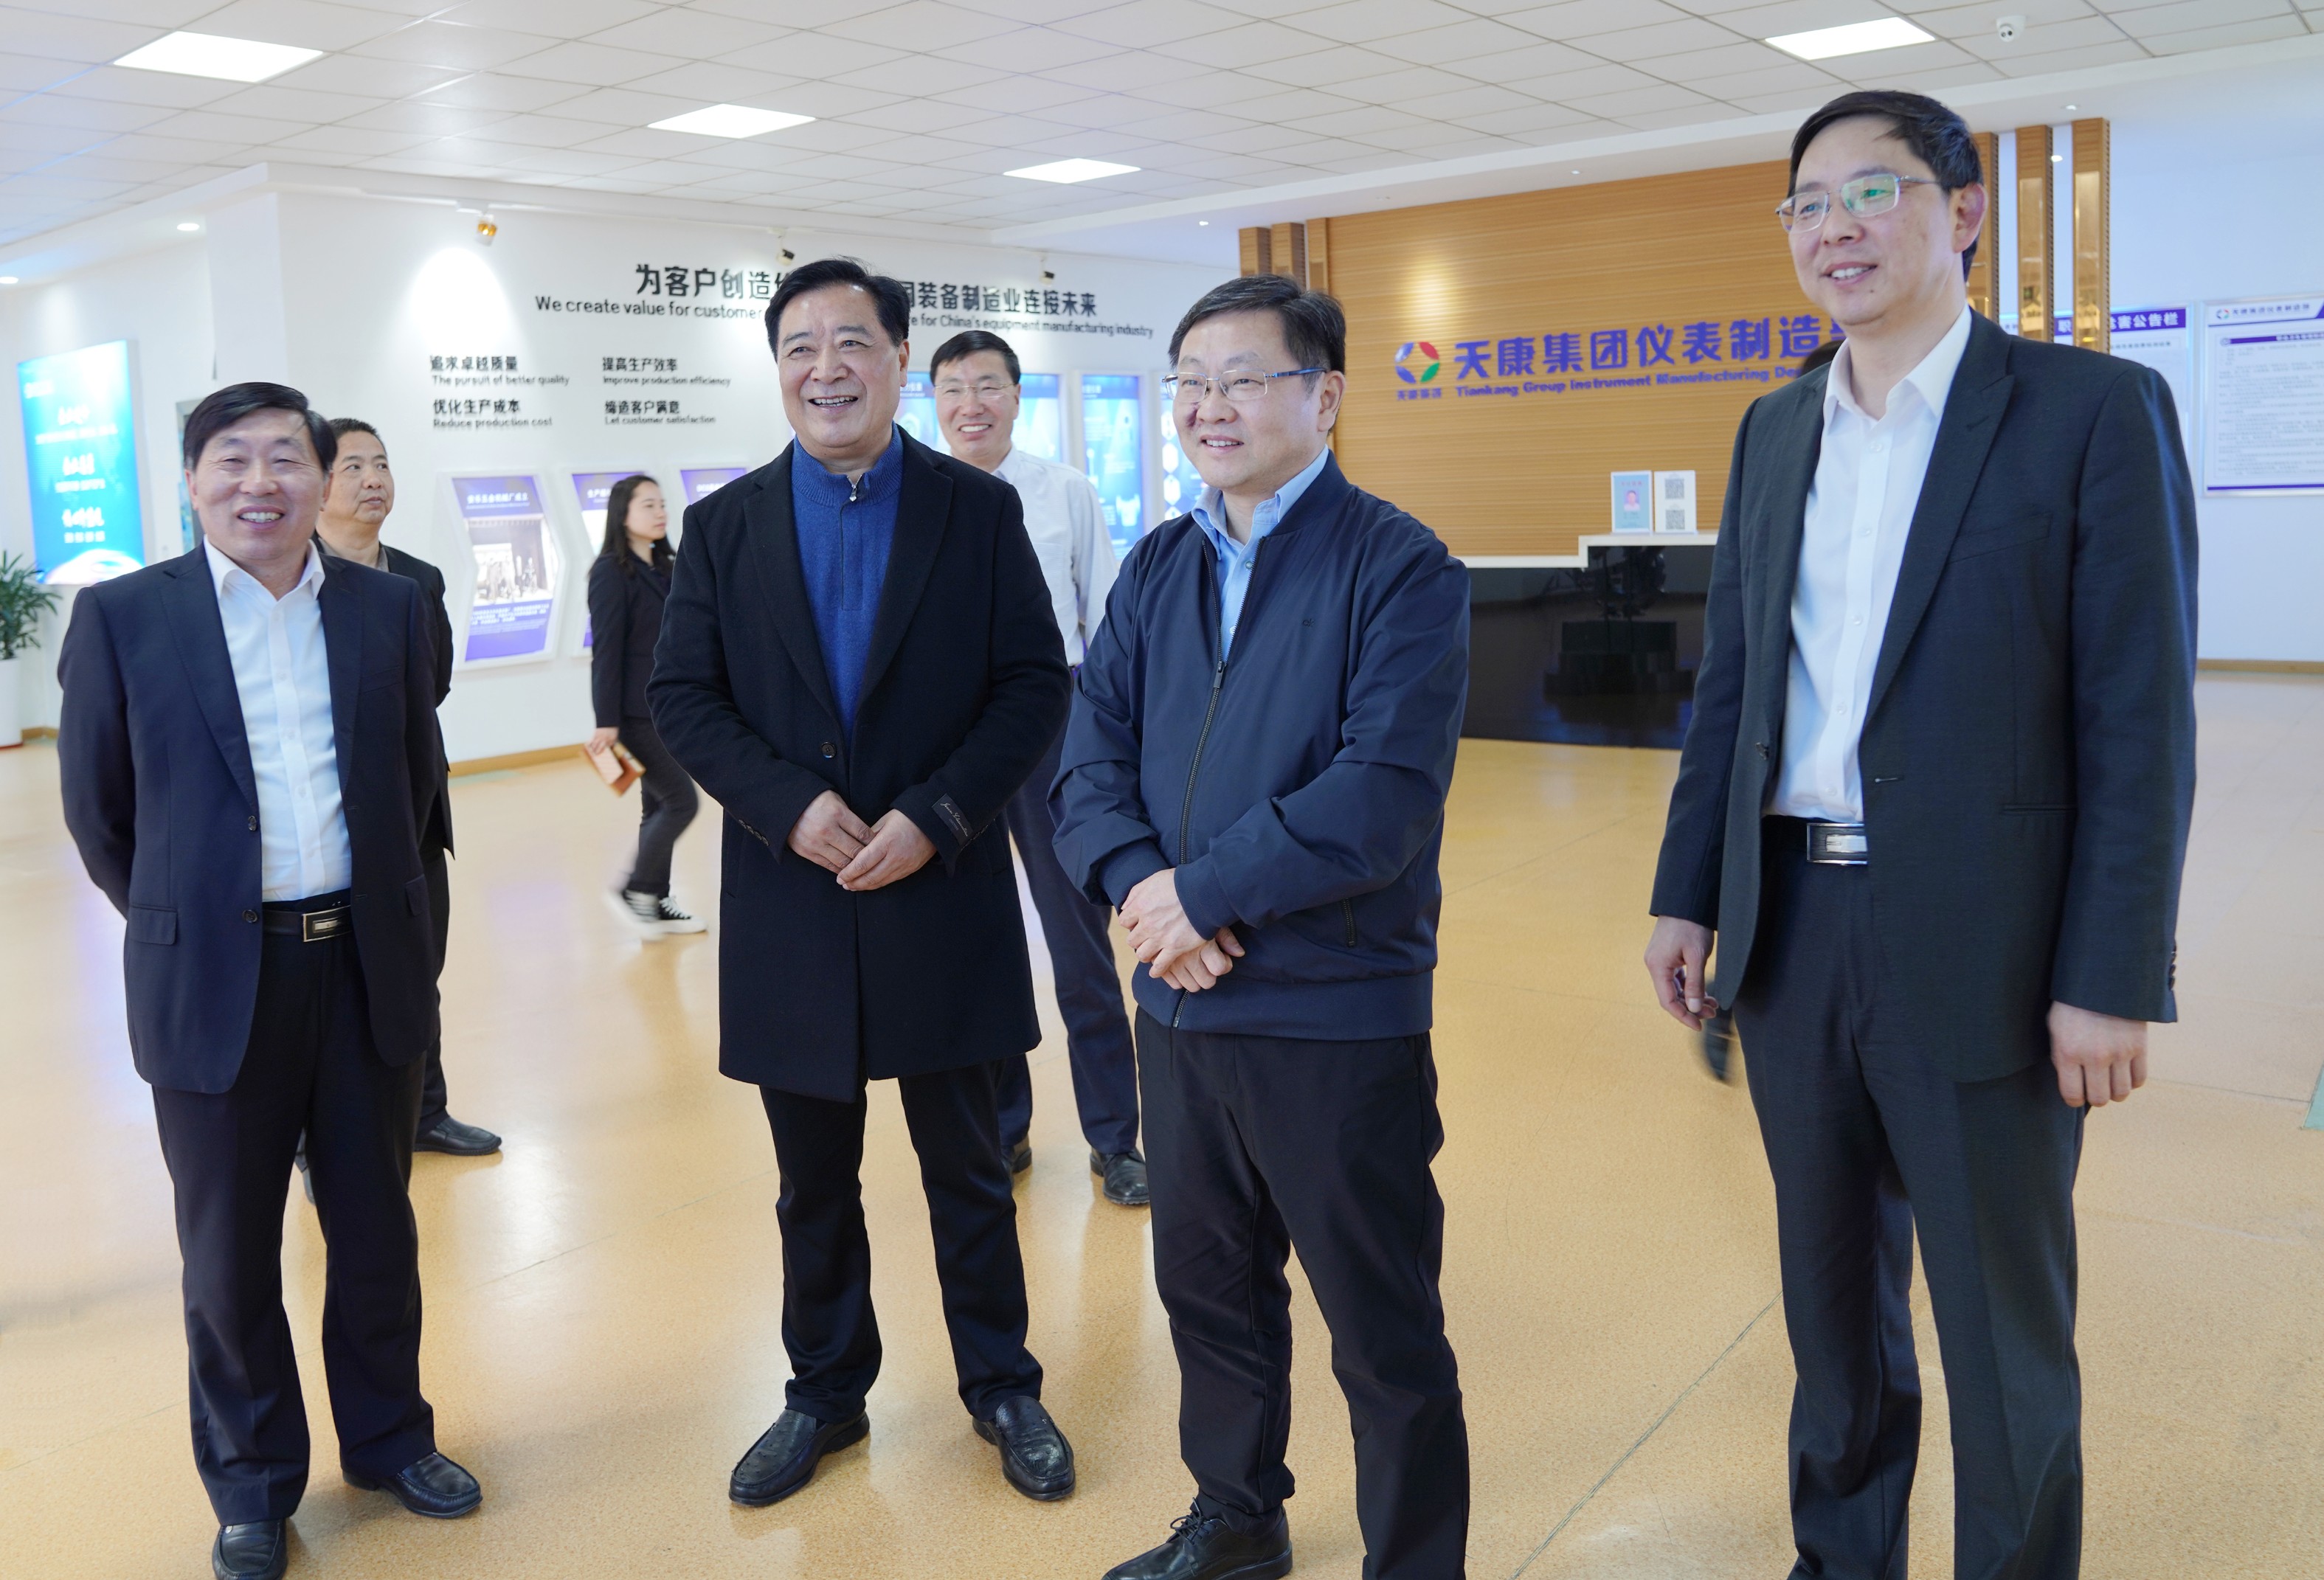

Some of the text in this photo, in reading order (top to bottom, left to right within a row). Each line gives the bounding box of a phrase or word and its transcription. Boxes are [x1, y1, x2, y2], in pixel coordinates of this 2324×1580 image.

[535, 296, 561, 313] We
[566, 299, 620, 313] create
[623, 300, 665, 316] value
[669, 301, 690, 316] for
[921, 313, 938, 326] for
[940, 315, 981, 328] China's
[983, 317, 1041, 333] equipment
[1042, 320, 1113, 337] manufacturing
[1115, 323, 1154, 339] industry
[603, 357, 677, 372] 提高生产效率
[432, 375, 570, 387] The pursuit of better quality
[604, 375, 731, 388] Improve production efficiency
[1455, 384, 1519, 398] Tiankang
[1523, 380, 1566, 393] Group
[1570, 374, 1651, 390] Instrument
[1656, 366, 1770, 385] Manufacturing
[433, 399, 519, 415] 优化生产成本
[433, 417, 553, 429] Reduce production cost
[622, 416, 663, 425] customer
[666, 415, 716, 424] satisfaction
